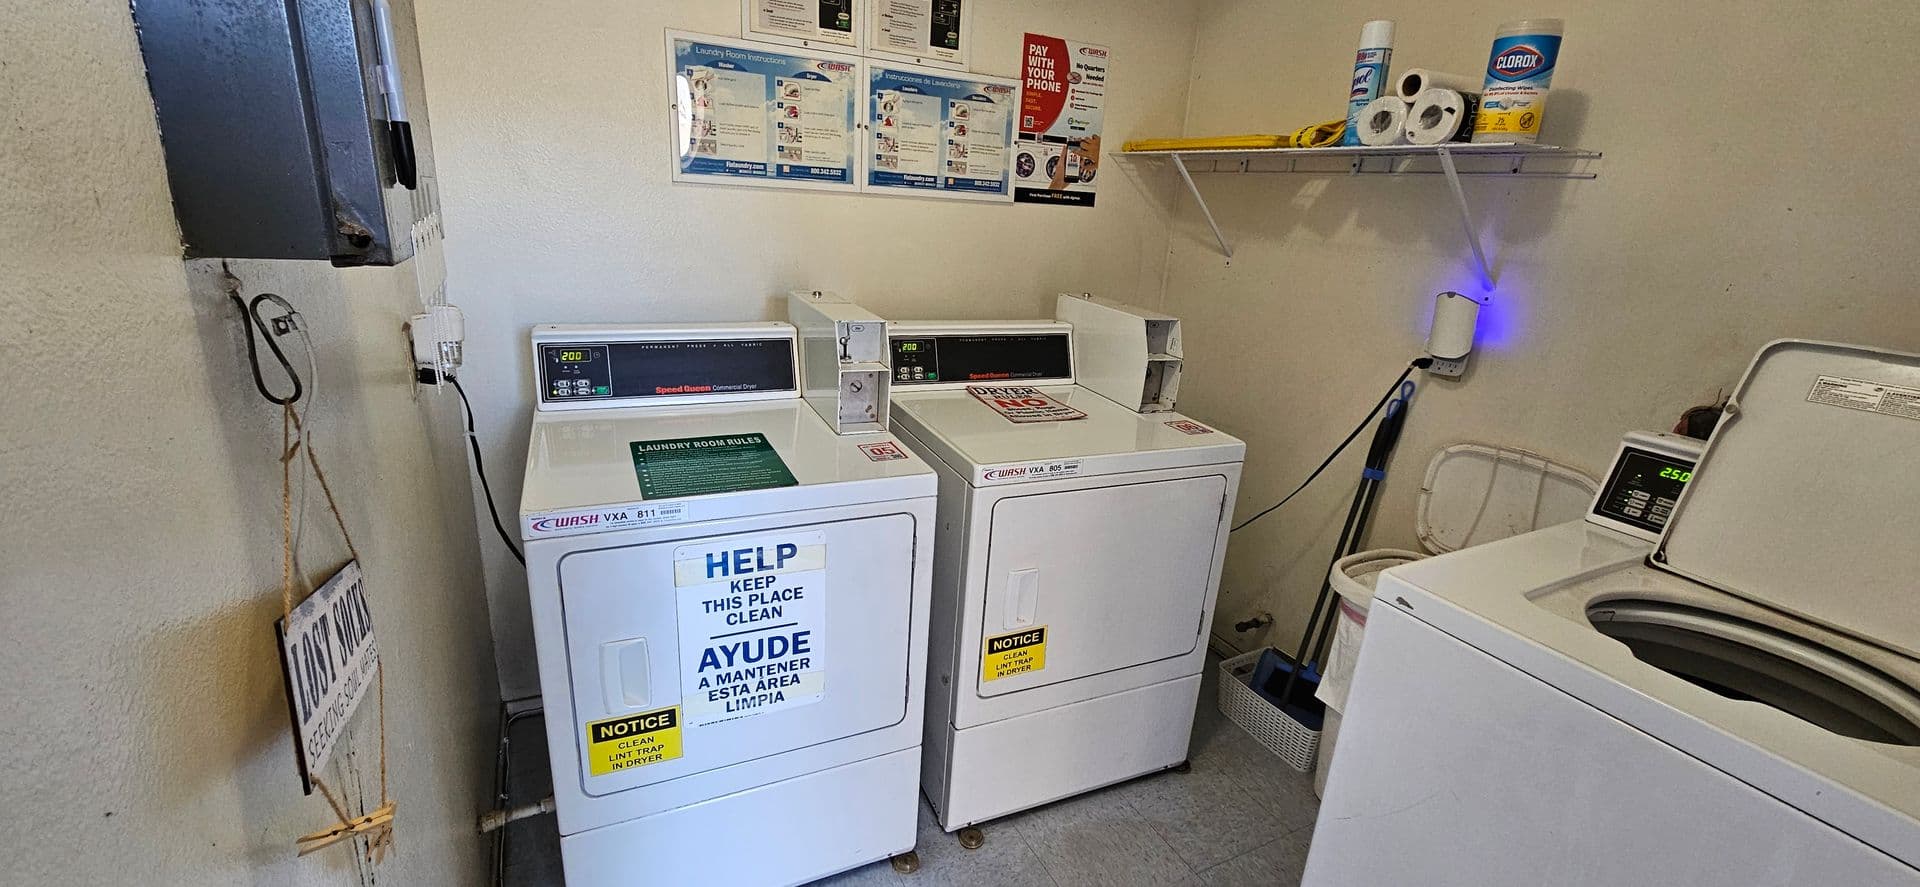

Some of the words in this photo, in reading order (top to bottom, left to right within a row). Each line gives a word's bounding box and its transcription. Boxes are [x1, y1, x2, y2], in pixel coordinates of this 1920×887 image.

[695, 46, 724, 58] Laundry
[725, 50, 747, 60] Room
[747, 53, 786, 65] Instructions
[1029, 44, 1048, 57] PAY
[828, 63, 851, 72] WASH
[1028, 56, 1055, 69] WITH
[1084, 63, 1105, 73] Quarters
[1496, 54, 1538, 69] CLOROX
[885, 72, 923, 84] Instrucciones
[1027, 66, 1055, 81] YOUR
[1086, 74, 1104, 82] Needed
[1026, 78, 1062, 93] PHONE
[902, 343, 917, 351] 200
[562, 351, 582, 361] 200
[655, 386, 683, 395] Speed
[683, 385, 711, 393] Queen
[743, 383, 757, 391] Dryer
[972, 387, 1039, 395] DRYER
[994, 398, 1048, 409] NO
[639, 441, 691, 452] LAUNDRY
[693, 438, 726, 449] ROOM
[727, 436, 762, 446] RULES
[870, 447, 896, 456] 05
[998, 467, 1027, 478] WASH
[1029, 466, 1044, 474] VXA
[1049, 464, 1062, 472] 805
[555, 514, 599, 528] WASH
[604, 512, 628, 522] VXA
[637, 509, 655, 519] 811
[706, 543, 797, 579] HELP
[730, 575, 776, 594] KEEP
[702, 596, 742, 614] THIS
[749, 586, 803, 607] PLACE
[726, 605, 782, 626] CLEAN
[993, 632, 1040, 651] NOTICE
[290, 612, 336, 726] LOST
[332, 578, 371, 668] SOCKS
[698, 630, 811, 674] AYUDE
[1003, 650, 1028, 661] CLEAN
[996, 661, 1012, 671] LINT
[1014, 656, 1034, 665] TRAP
[1006, 664, 1032, 676] DRYER
[698, 677, 710, 690] A
[716, 657, 810, 686] MANTENER
[708, 684, 750, 702] ESTA
[755, 673, 800, 692] ÁREA
[308, 692, 345, 768] SEEKING
[343, 666, 362, 708] SOUL
[360, 639, 378, 682] MATES
[726, 691, 785, 713] LIMPIA
[600, 713, 670, 738] NOTICE
[618, 736, 655, 750] CLEAN
[609, 750, 632, 762] LINT
[636, 744, 664, 756] TRAP
[612, 762, 623, 770] IN
[626, 753, 663, 768] DRYER
